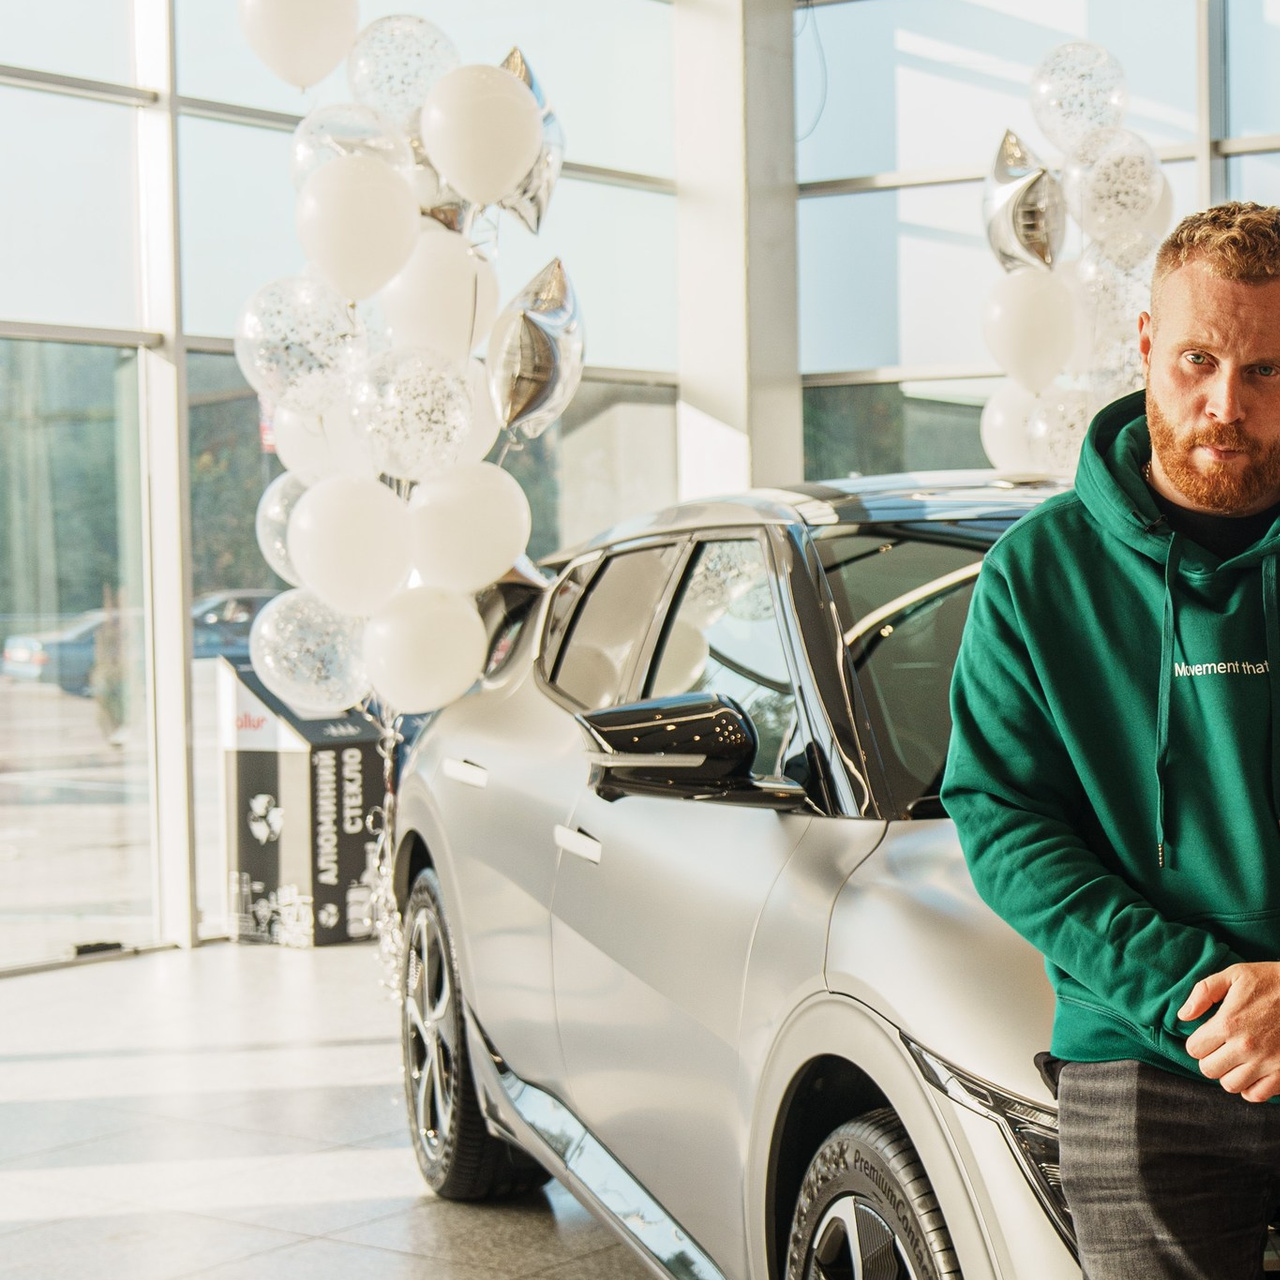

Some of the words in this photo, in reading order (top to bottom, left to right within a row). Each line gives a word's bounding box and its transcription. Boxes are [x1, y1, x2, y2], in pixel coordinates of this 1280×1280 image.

[1174, 661, 1240, 677] Movement
[1241, 660, 1270, 675] that
[312, 749, 339, 886] АЛЮМИНИЙ
[341, 747, 364, 835] СТЕКЛО
